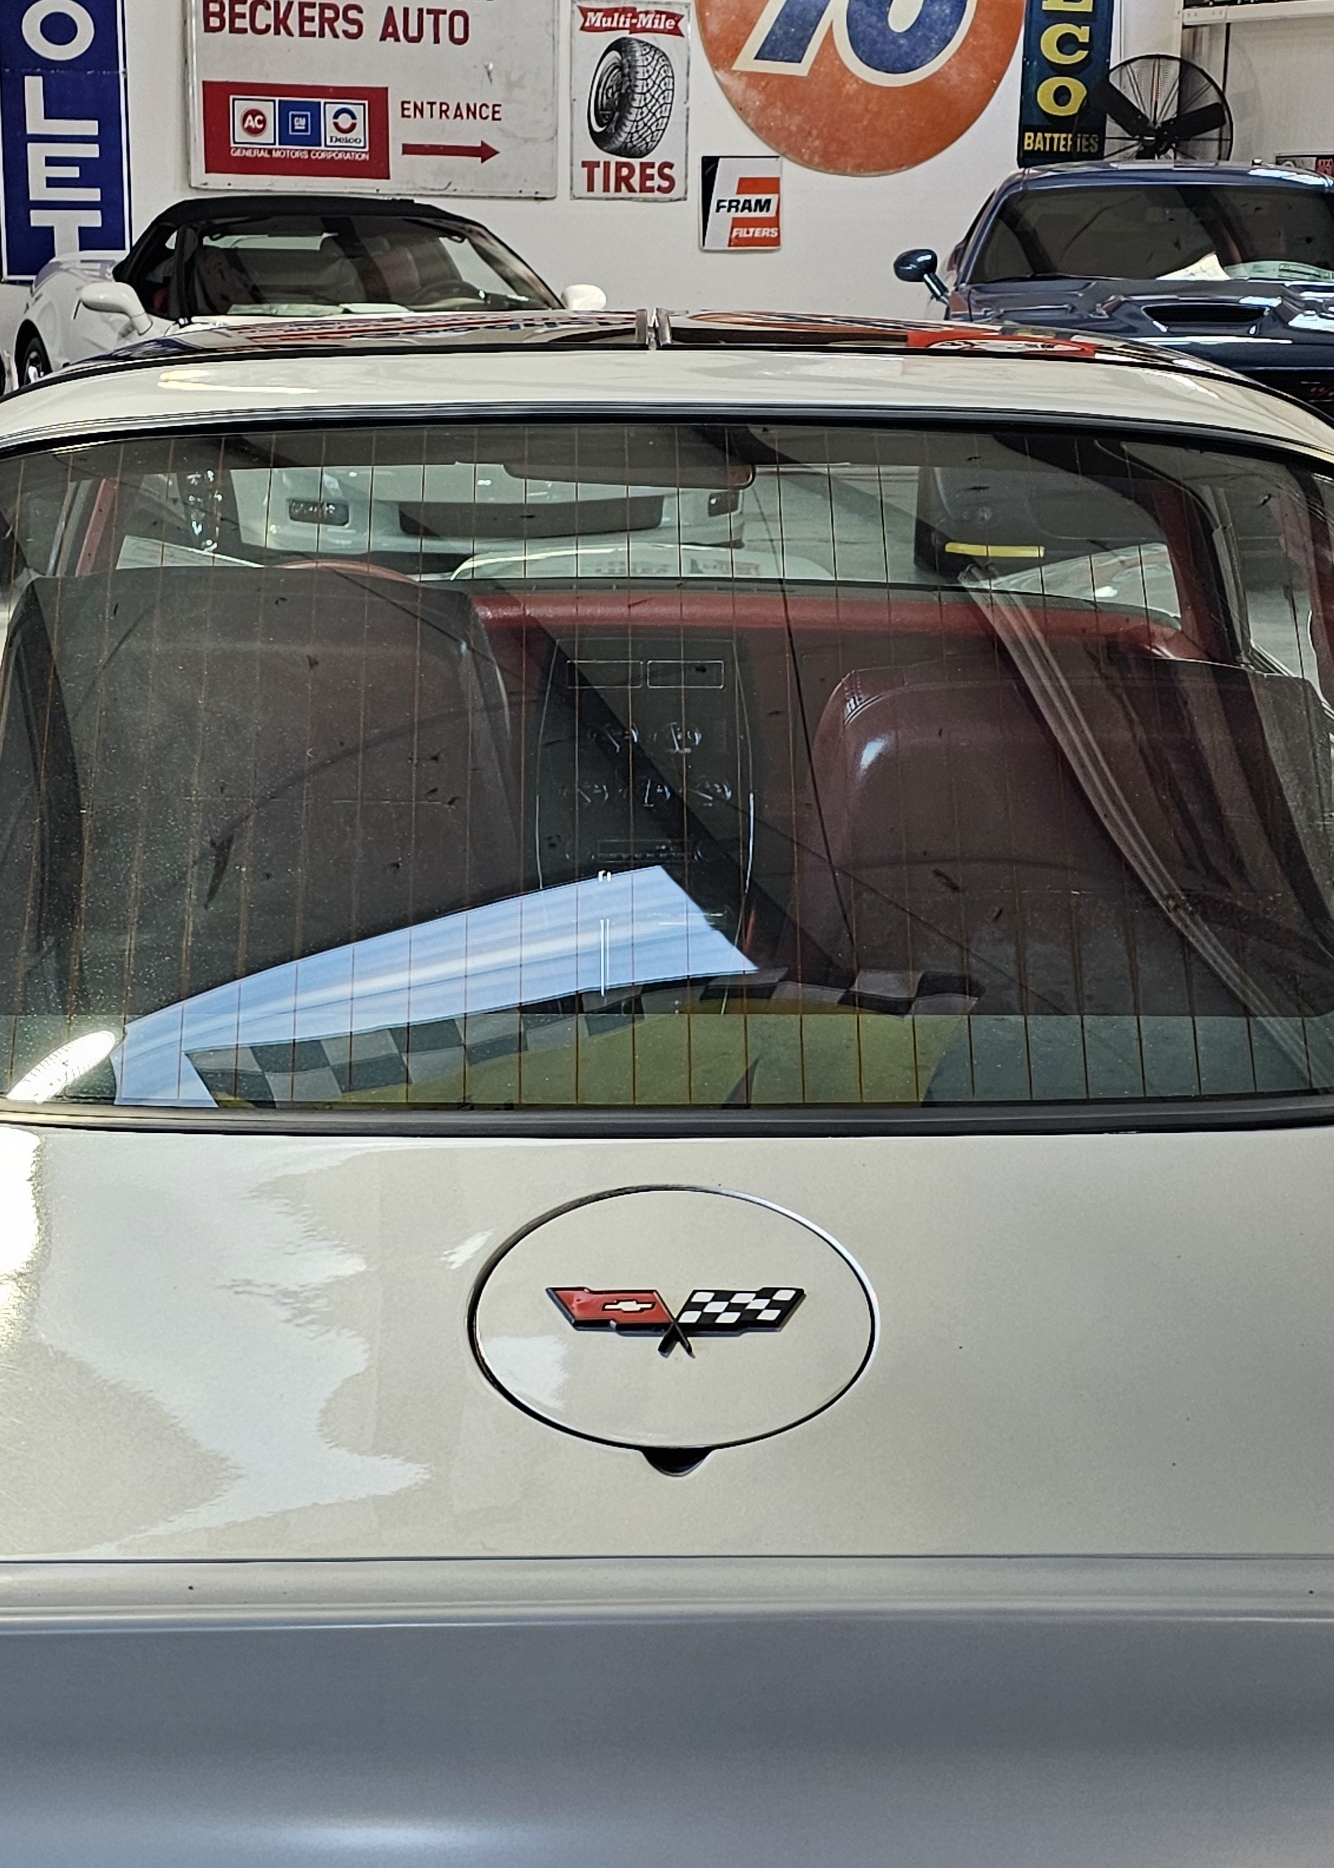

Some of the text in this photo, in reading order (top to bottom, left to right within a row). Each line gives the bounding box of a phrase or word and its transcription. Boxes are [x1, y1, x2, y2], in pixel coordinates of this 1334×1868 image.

[202, 0, 470, 45] BECKERS AUTO
[584, 12, 676, 31] Multi-Mile
[401, 101, 502, 121] ENTRANCE
[243, 115, 264, 129] AC
[329, 136, 362, 144] Delco
[230, 148, 369, 161] GENERAL MOTORS CORPORATION
[581, 160, 676, 195] TIRES
[715, 198, 772, 213] FRAM
[732, 227, 779, 238] FILTERS
